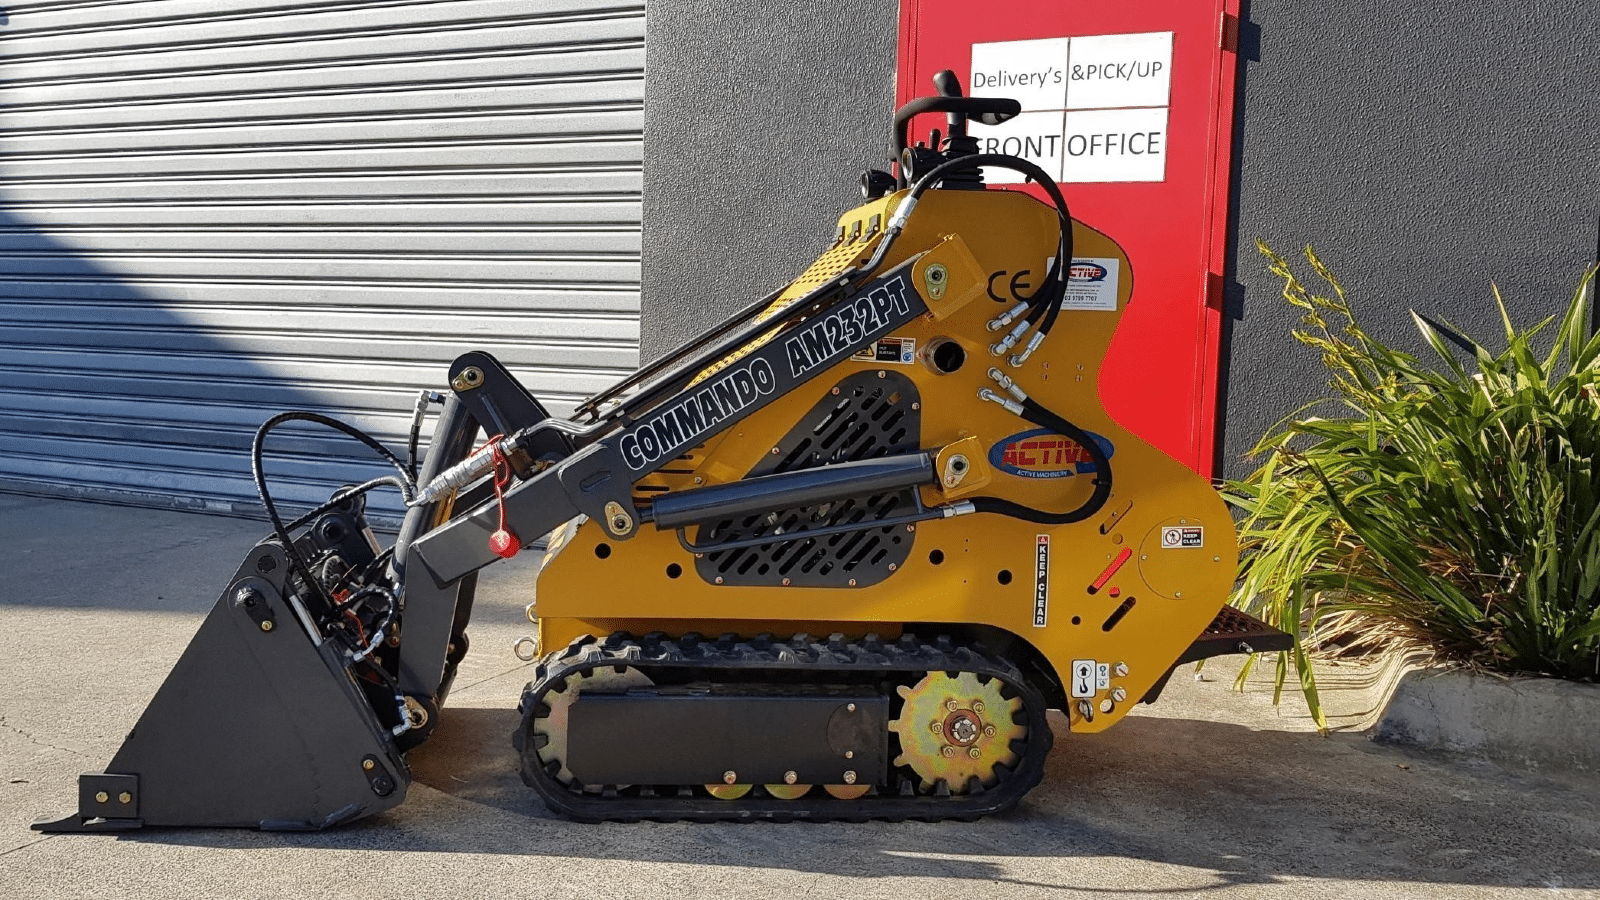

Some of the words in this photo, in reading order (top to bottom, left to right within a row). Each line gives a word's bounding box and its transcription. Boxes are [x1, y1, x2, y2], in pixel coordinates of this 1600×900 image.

[973, 66, 1062, 88] Delivery's
[1071, 61, 1163, 81] &PICK/UP
[1067, 132, 1161, 156] OFFICE
[987, 269, 1030, 303] CE
[619, 357, 776, 471] COMMANDO
[785, 275, 909, 378] AM232PT
[1038, 545, 1047, 579] KEEP
[1036, 583, 1046, 624] CLEAR
